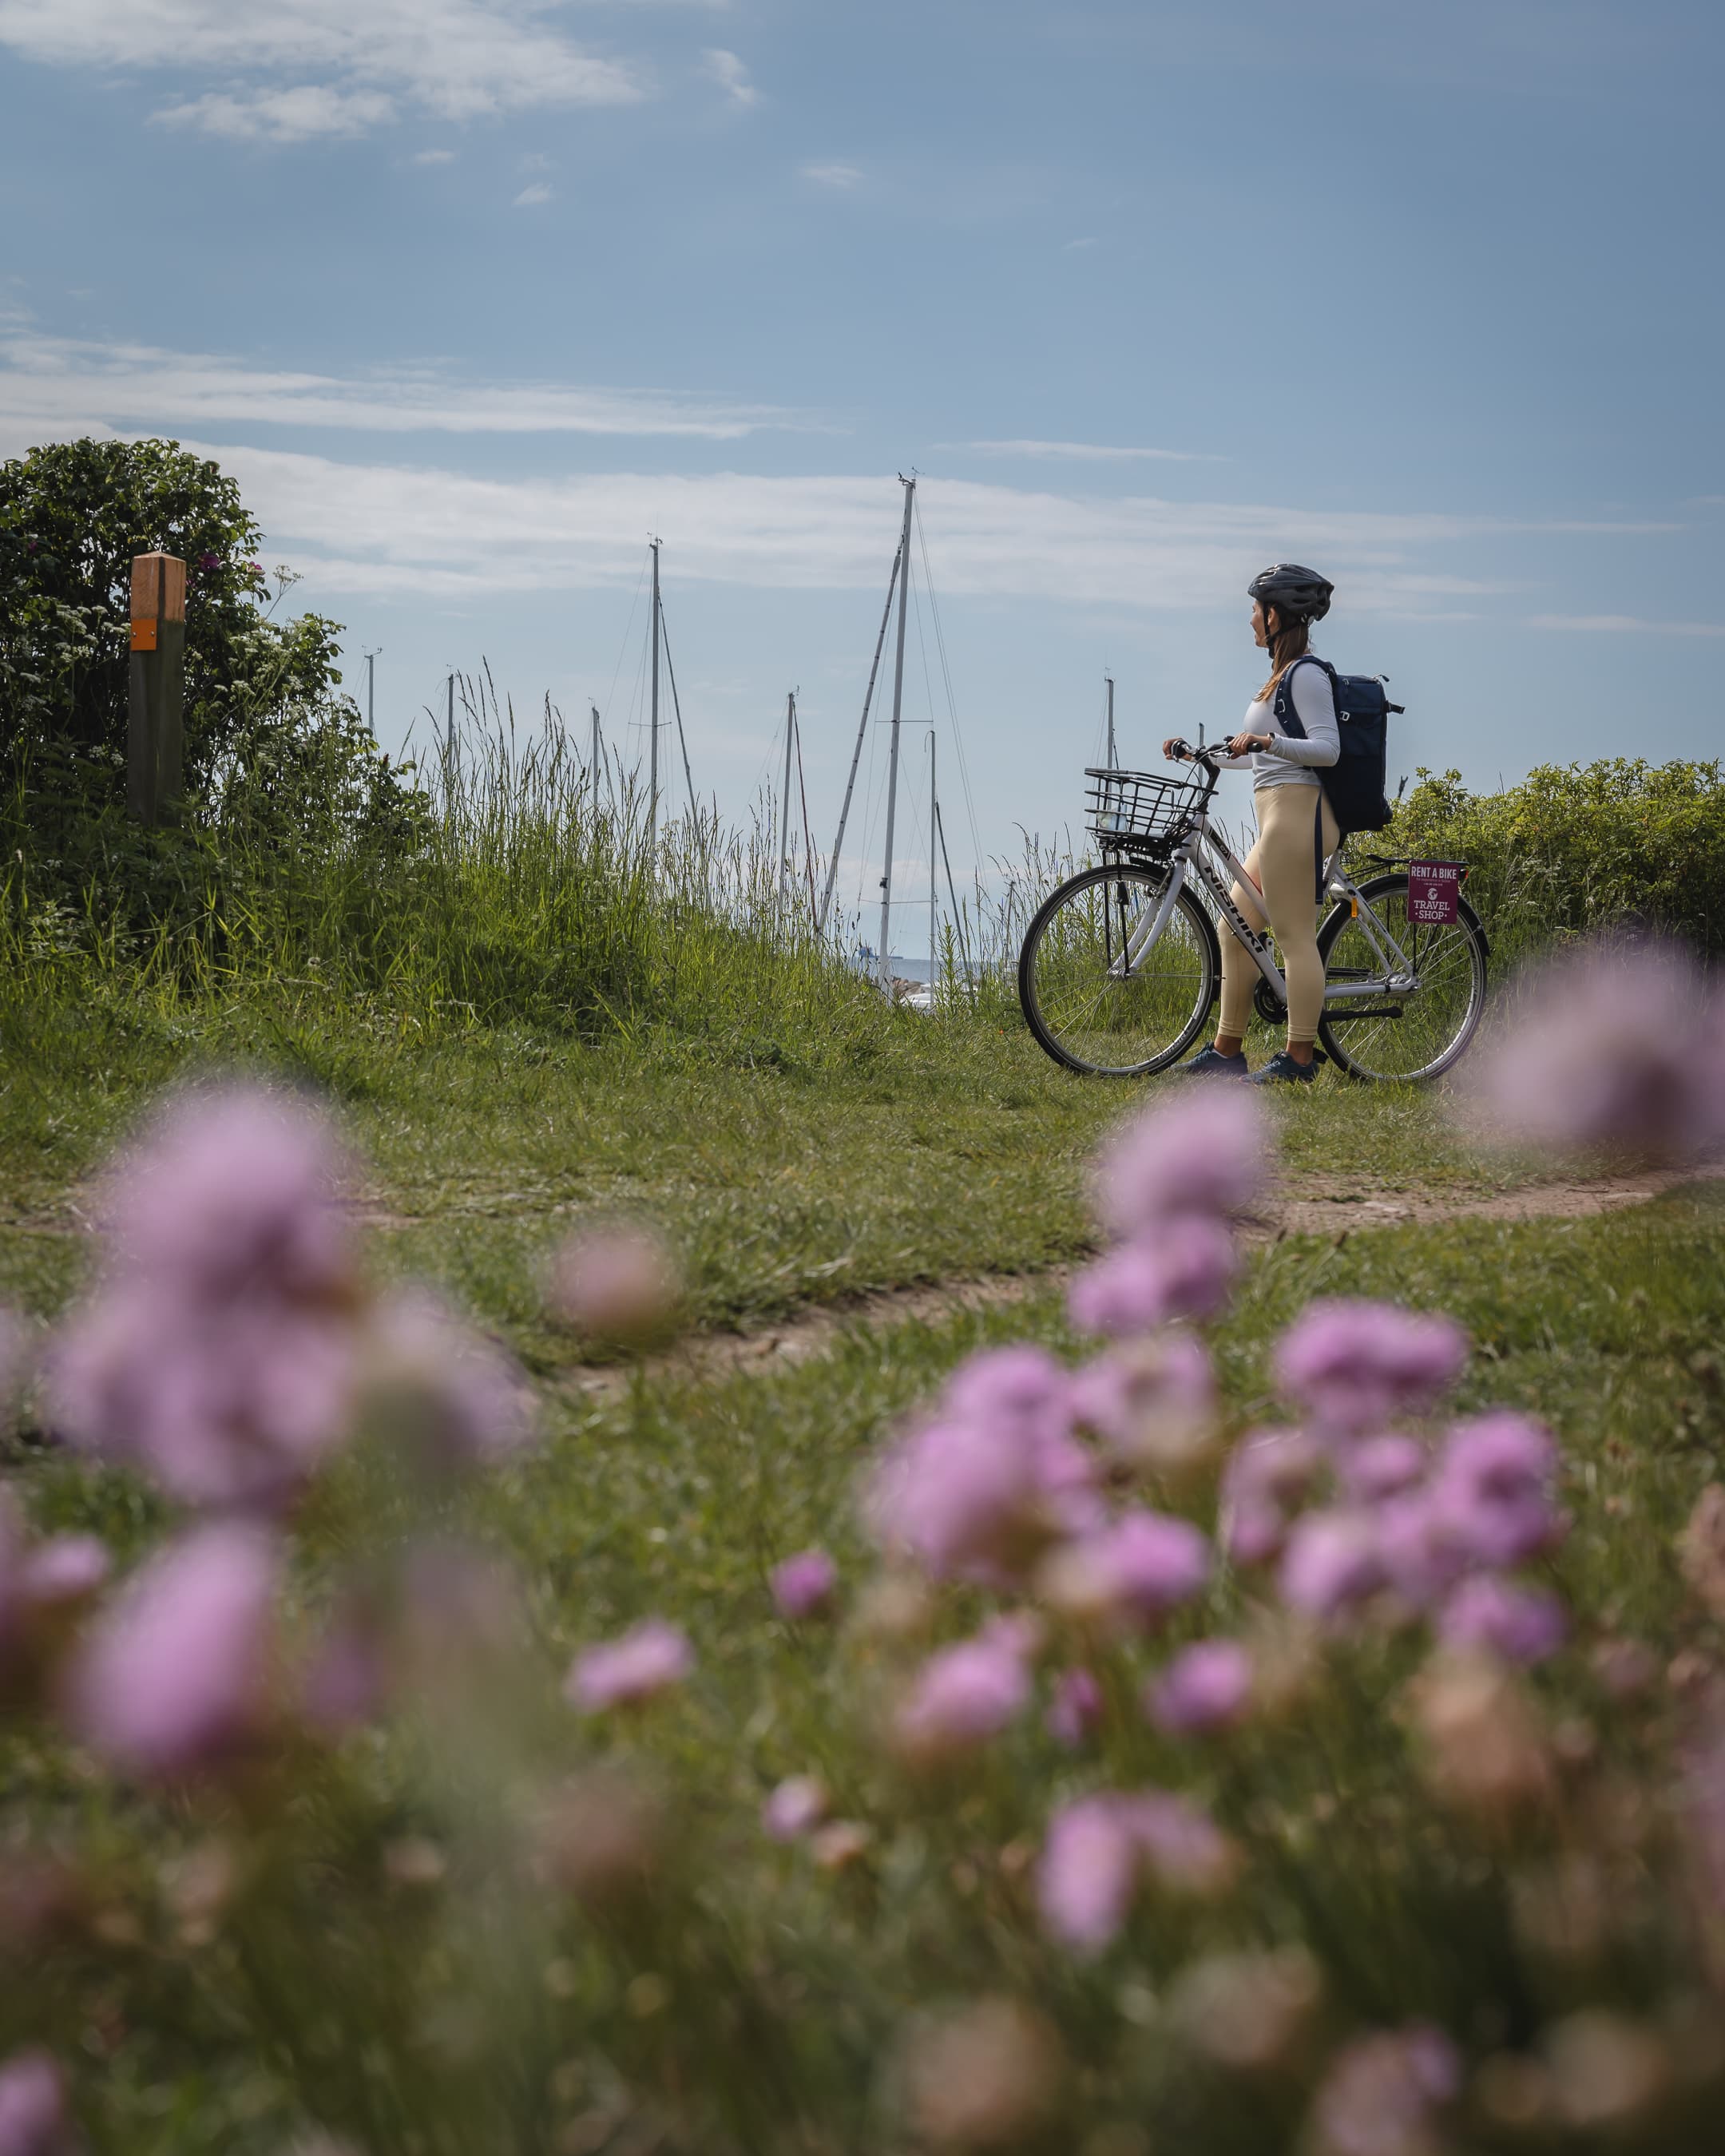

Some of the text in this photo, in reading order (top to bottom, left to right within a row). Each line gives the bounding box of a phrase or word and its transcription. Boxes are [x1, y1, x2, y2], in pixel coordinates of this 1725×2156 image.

[1411, 866, 1457, 879] RENT A BIKE
[1204, 866, 1263, 953] NISHIKI
[1414, 900, 1449, 910] TRAVEL
[1418, 910, 1444, 919] SHOP
